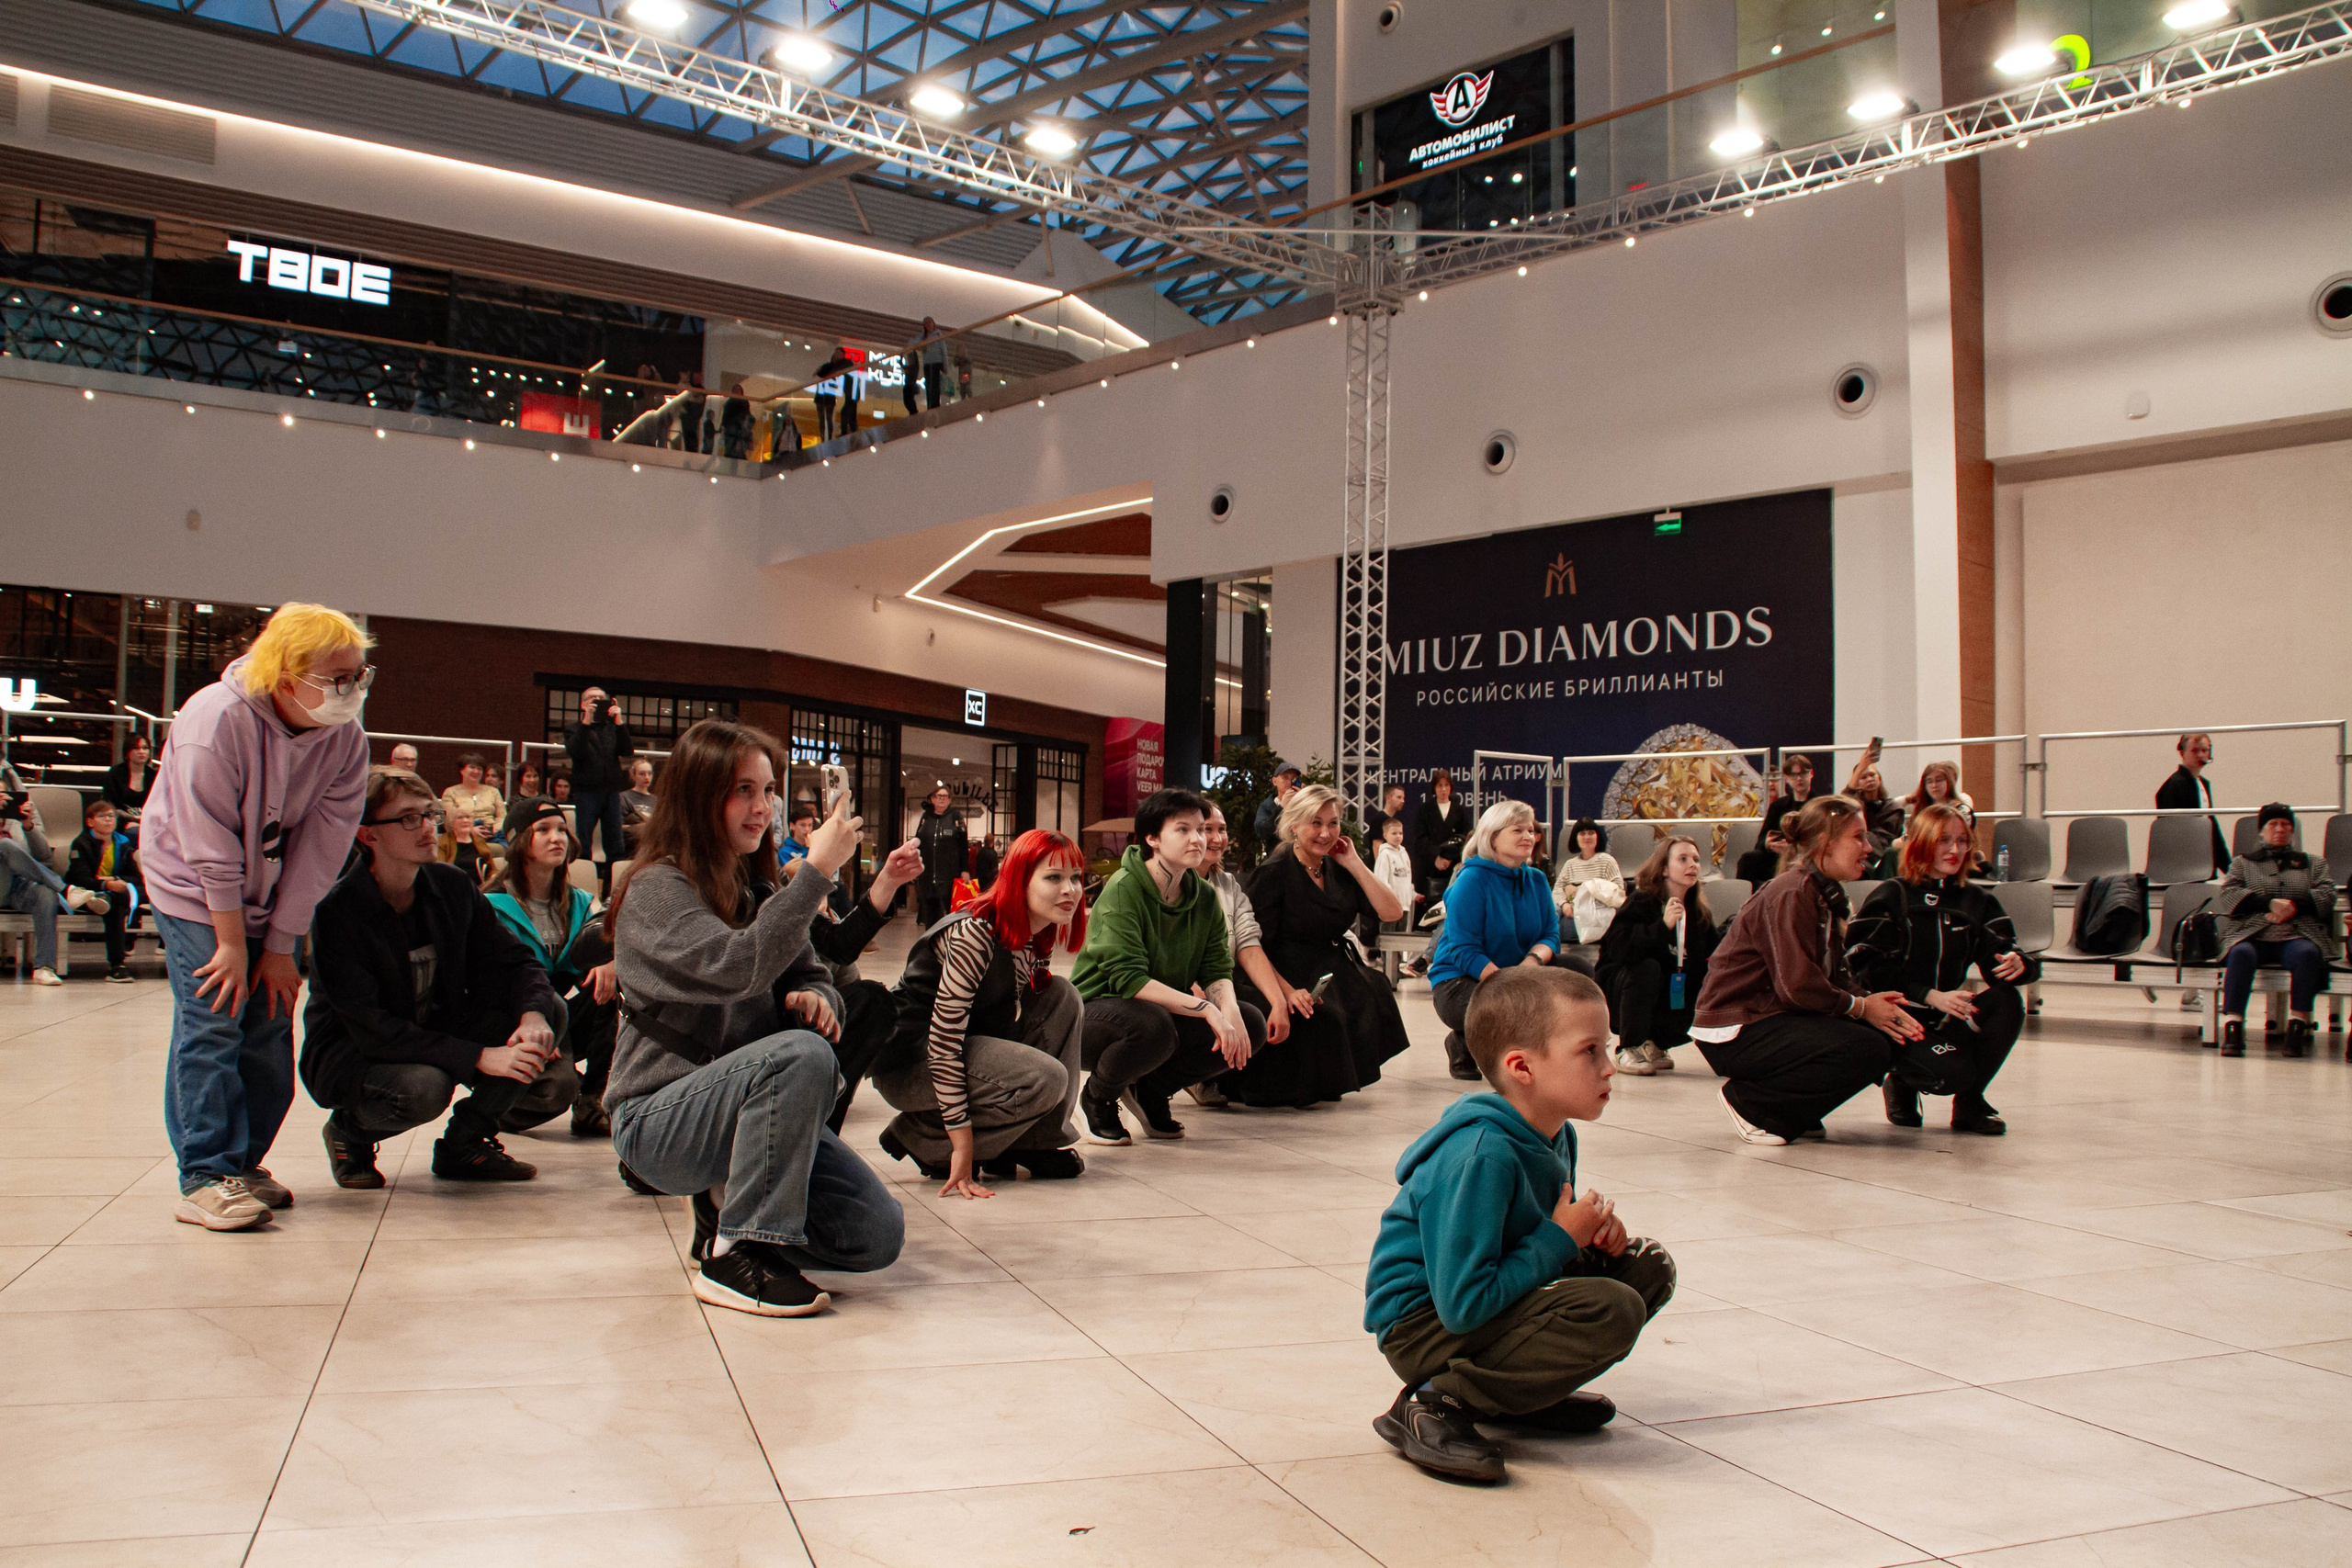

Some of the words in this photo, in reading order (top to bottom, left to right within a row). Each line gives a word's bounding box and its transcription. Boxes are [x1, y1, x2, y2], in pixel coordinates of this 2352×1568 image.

[1408, 115, 1515, 163] АВТОМОБИЛИСТ
[1421, 143, 1476, 169] хоккейный
[1479, 133, 1503, 150] клуб
[1385, 633, 1484, 676] MIUZ
[1498, 606, 1773, 667] DIAMONDS
[1416, 680, 1555, 706] РОССИЙСКИЕ
[1565, 669, 1724, 698] БРИЛЛИАНТЫ
[1136, 739, 1159, 752] НОВАЯ
[1136, 752, 1164, 767] ПОДАРО
[1136, 766, 1157, 780] КАРТА
[1492, 763, 1562, 781] АТРИУМ
